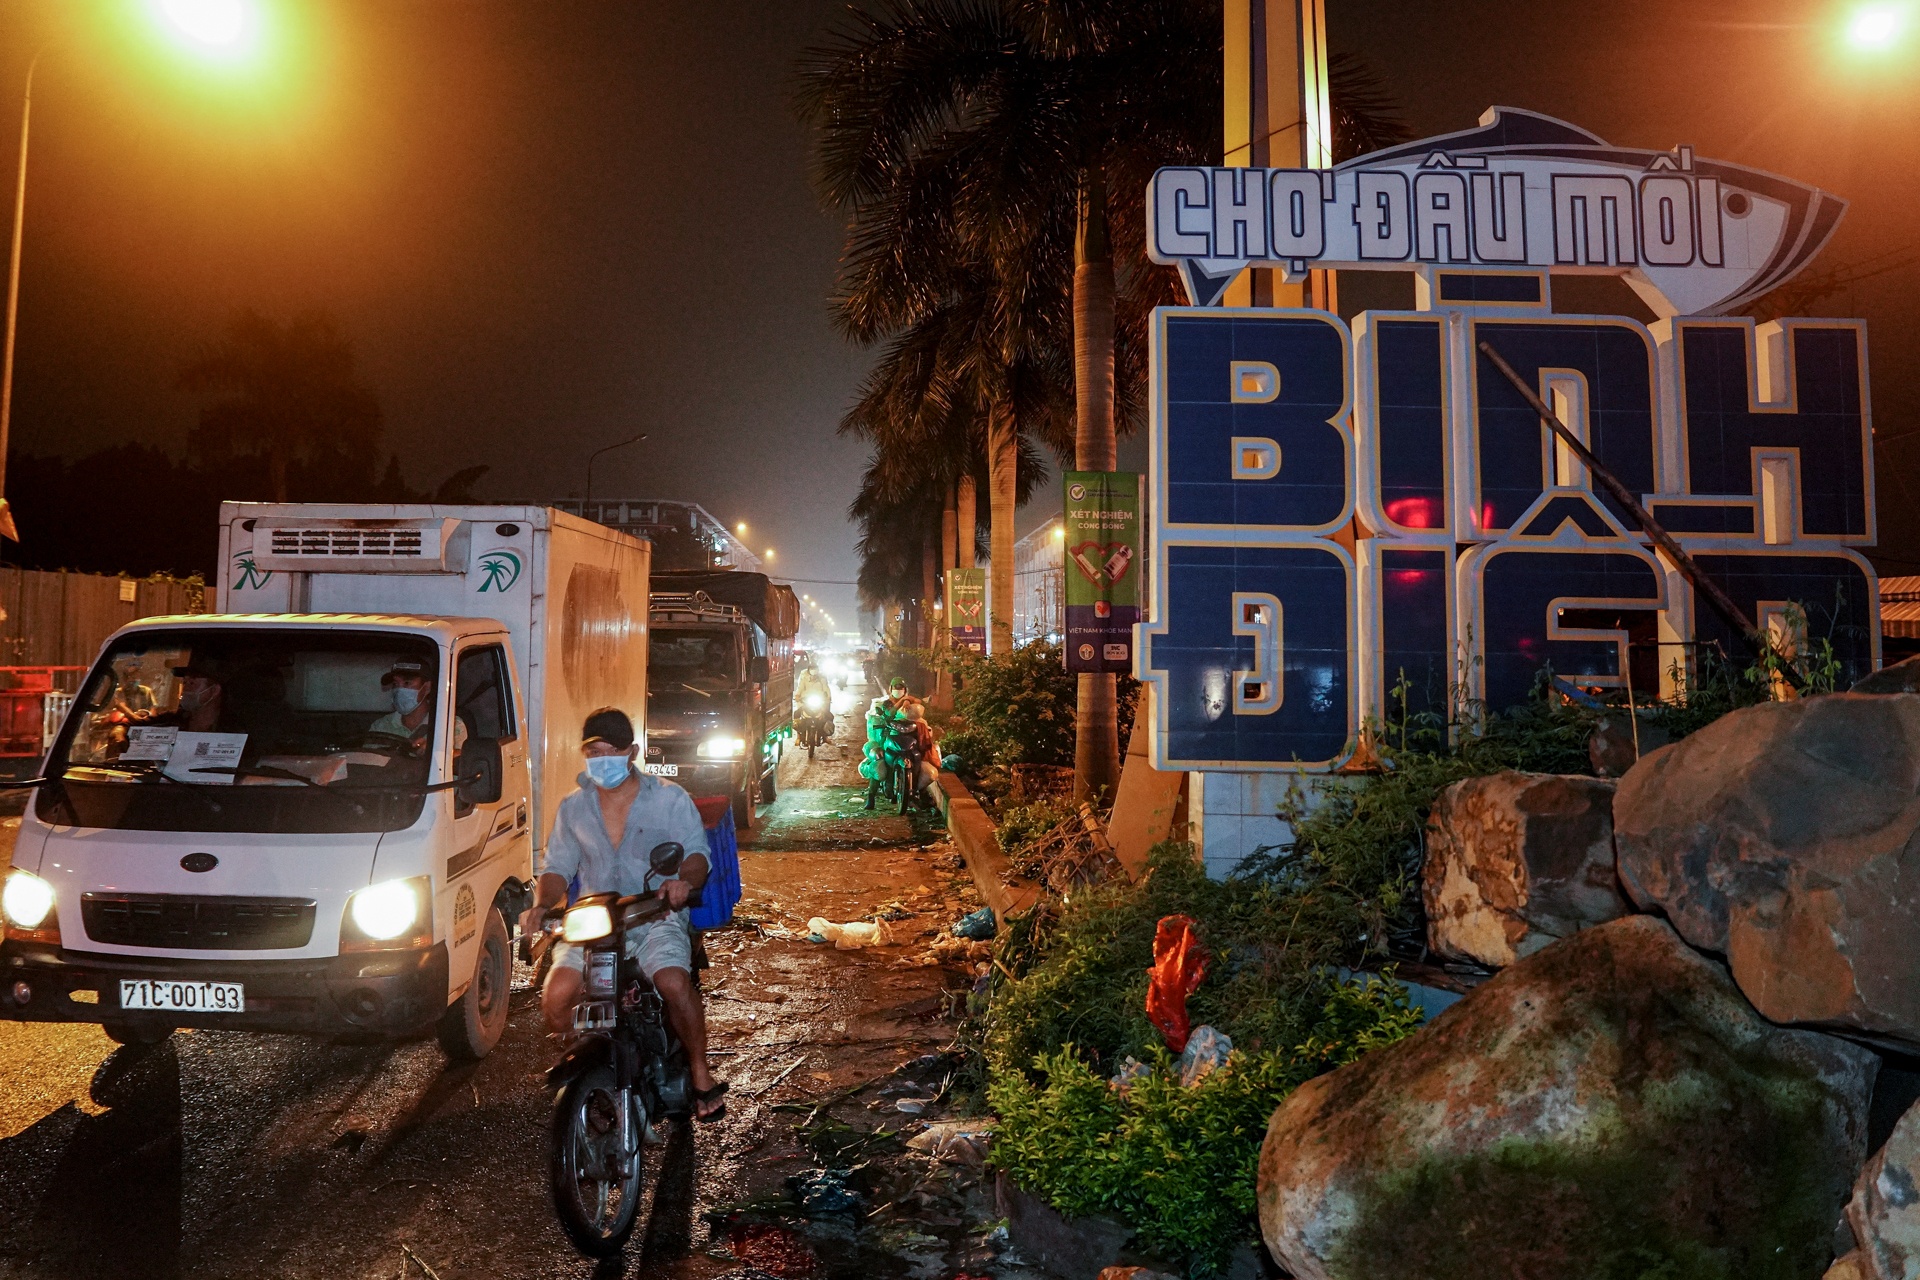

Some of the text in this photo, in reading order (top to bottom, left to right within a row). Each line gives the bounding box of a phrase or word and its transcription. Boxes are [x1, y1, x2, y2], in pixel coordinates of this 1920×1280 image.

[1153, 144, 1726, 275] CHỢ ĐẦU MỐI
[1148, 266, 1876, 548] BÌNH
[1069, 509, 1133, 522] XÉT NGHIỆM
[123, 982, 240, 1009] 71C-001.93
